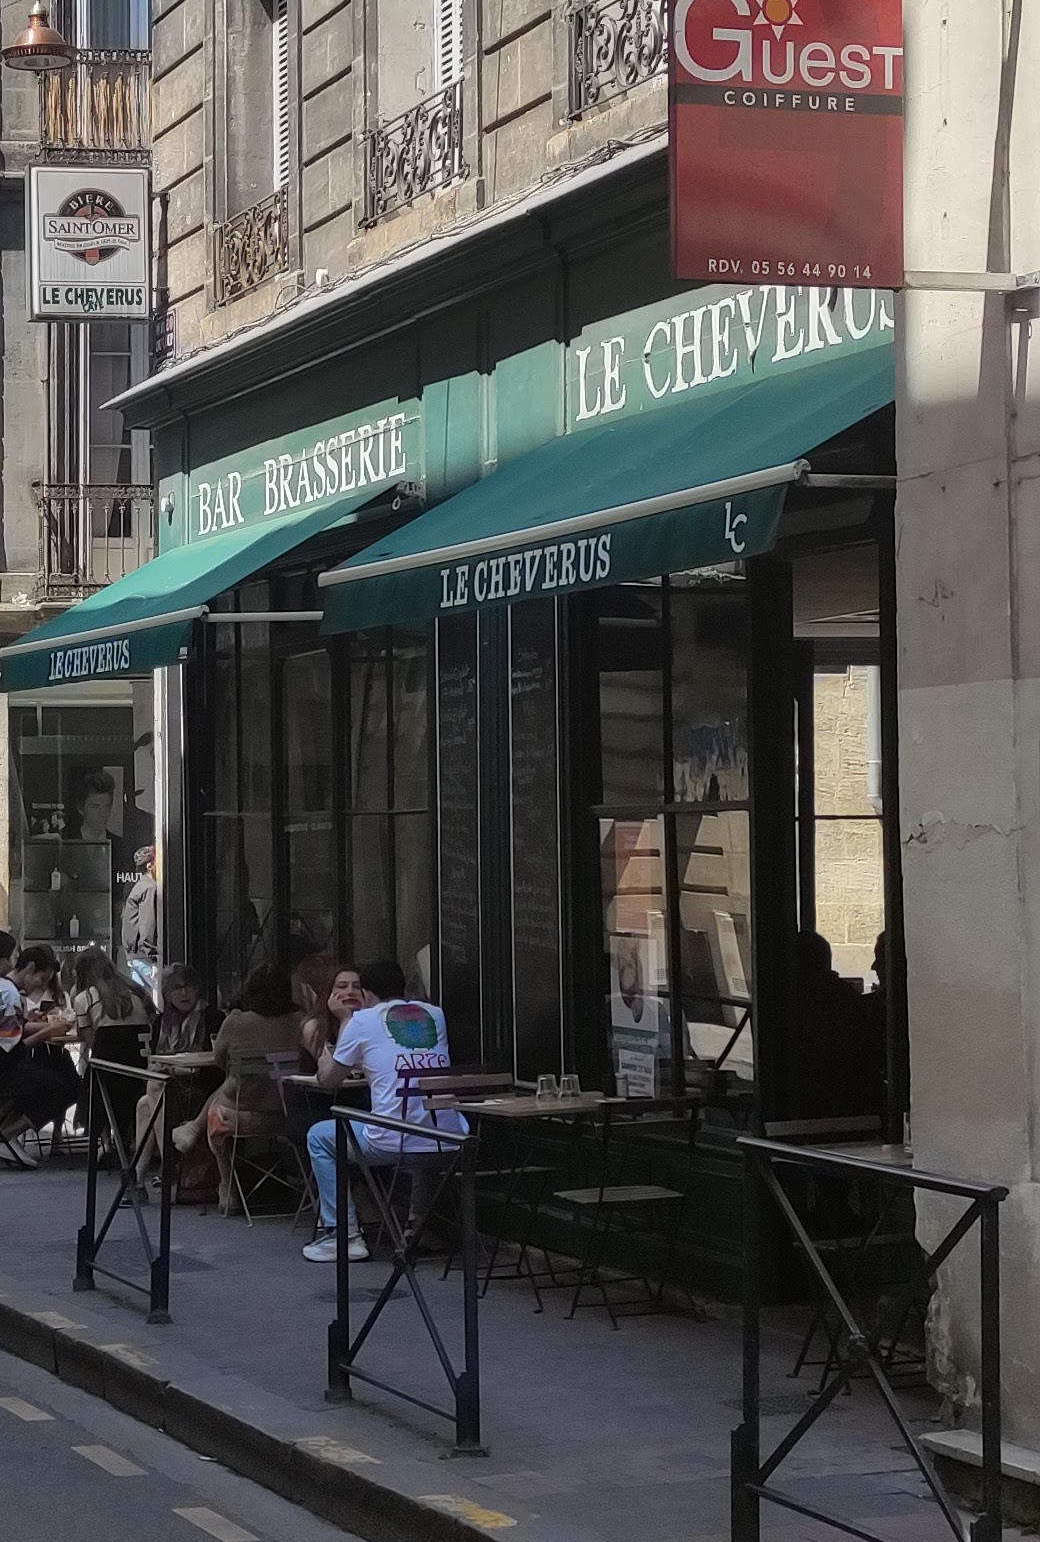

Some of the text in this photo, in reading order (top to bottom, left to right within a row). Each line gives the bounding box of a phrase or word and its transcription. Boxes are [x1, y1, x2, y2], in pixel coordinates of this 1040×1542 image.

[723, 90, 857, 112] COIFFURE
[708, 259, 872, 279] RDV. 05 56 44 90 14
[42, 287, 143, 306] LE CHEVERUS
[575, 335, 627, 422] LE
[198, 412, 406, 536] BAR BRASSERIE
[439, 532, 612, 609] LE CHEVERUS
